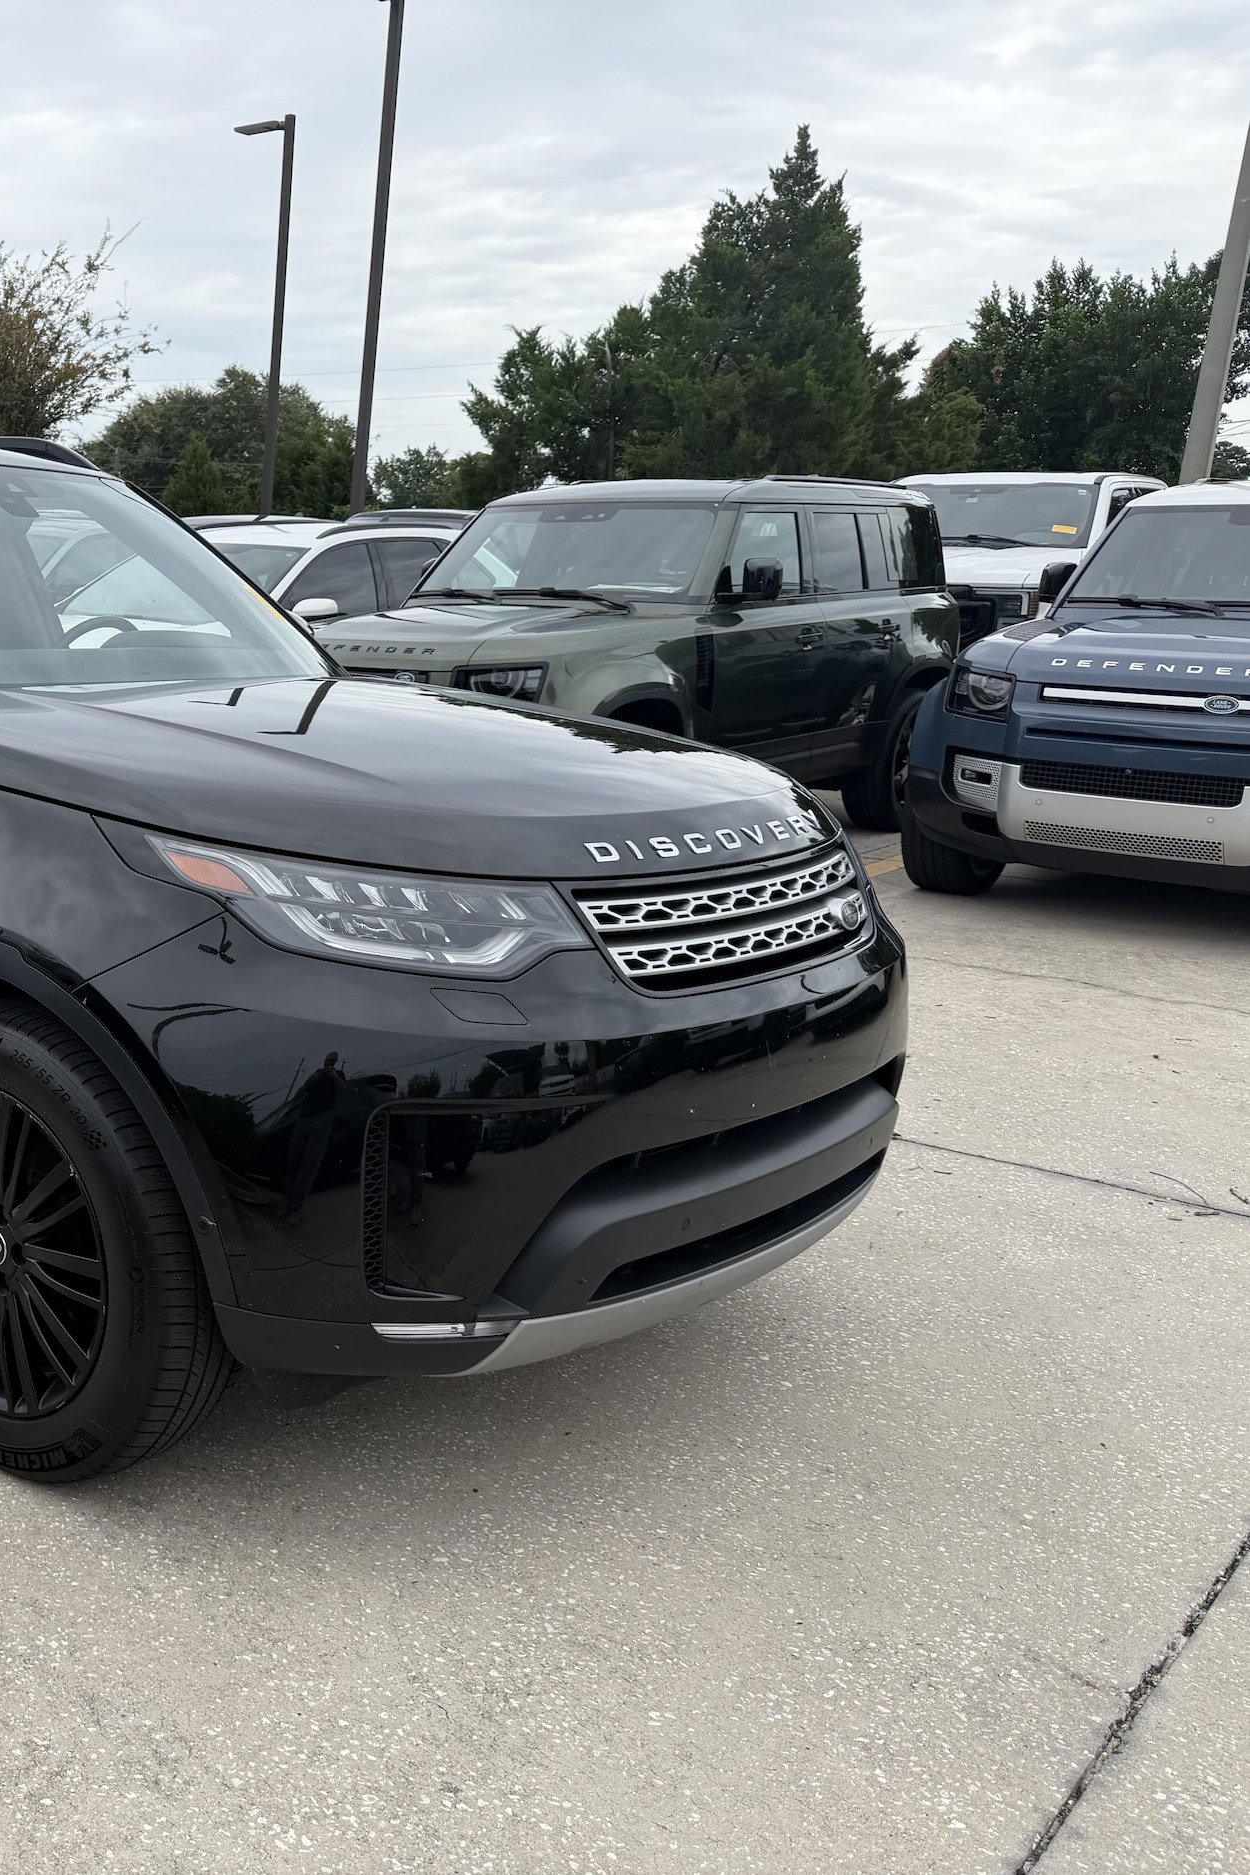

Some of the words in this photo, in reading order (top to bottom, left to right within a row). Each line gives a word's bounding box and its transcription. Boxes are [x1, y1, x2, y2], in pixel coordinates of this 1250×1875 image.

[321, 643, 436, 655] FENDER
[583, 808, 822, 863] DISCOVERY
[8, 1048, 54, 1086] 255/55
[51, 1084, 72, 1105] ZR
[69, 1107, 88, 1126] 20
